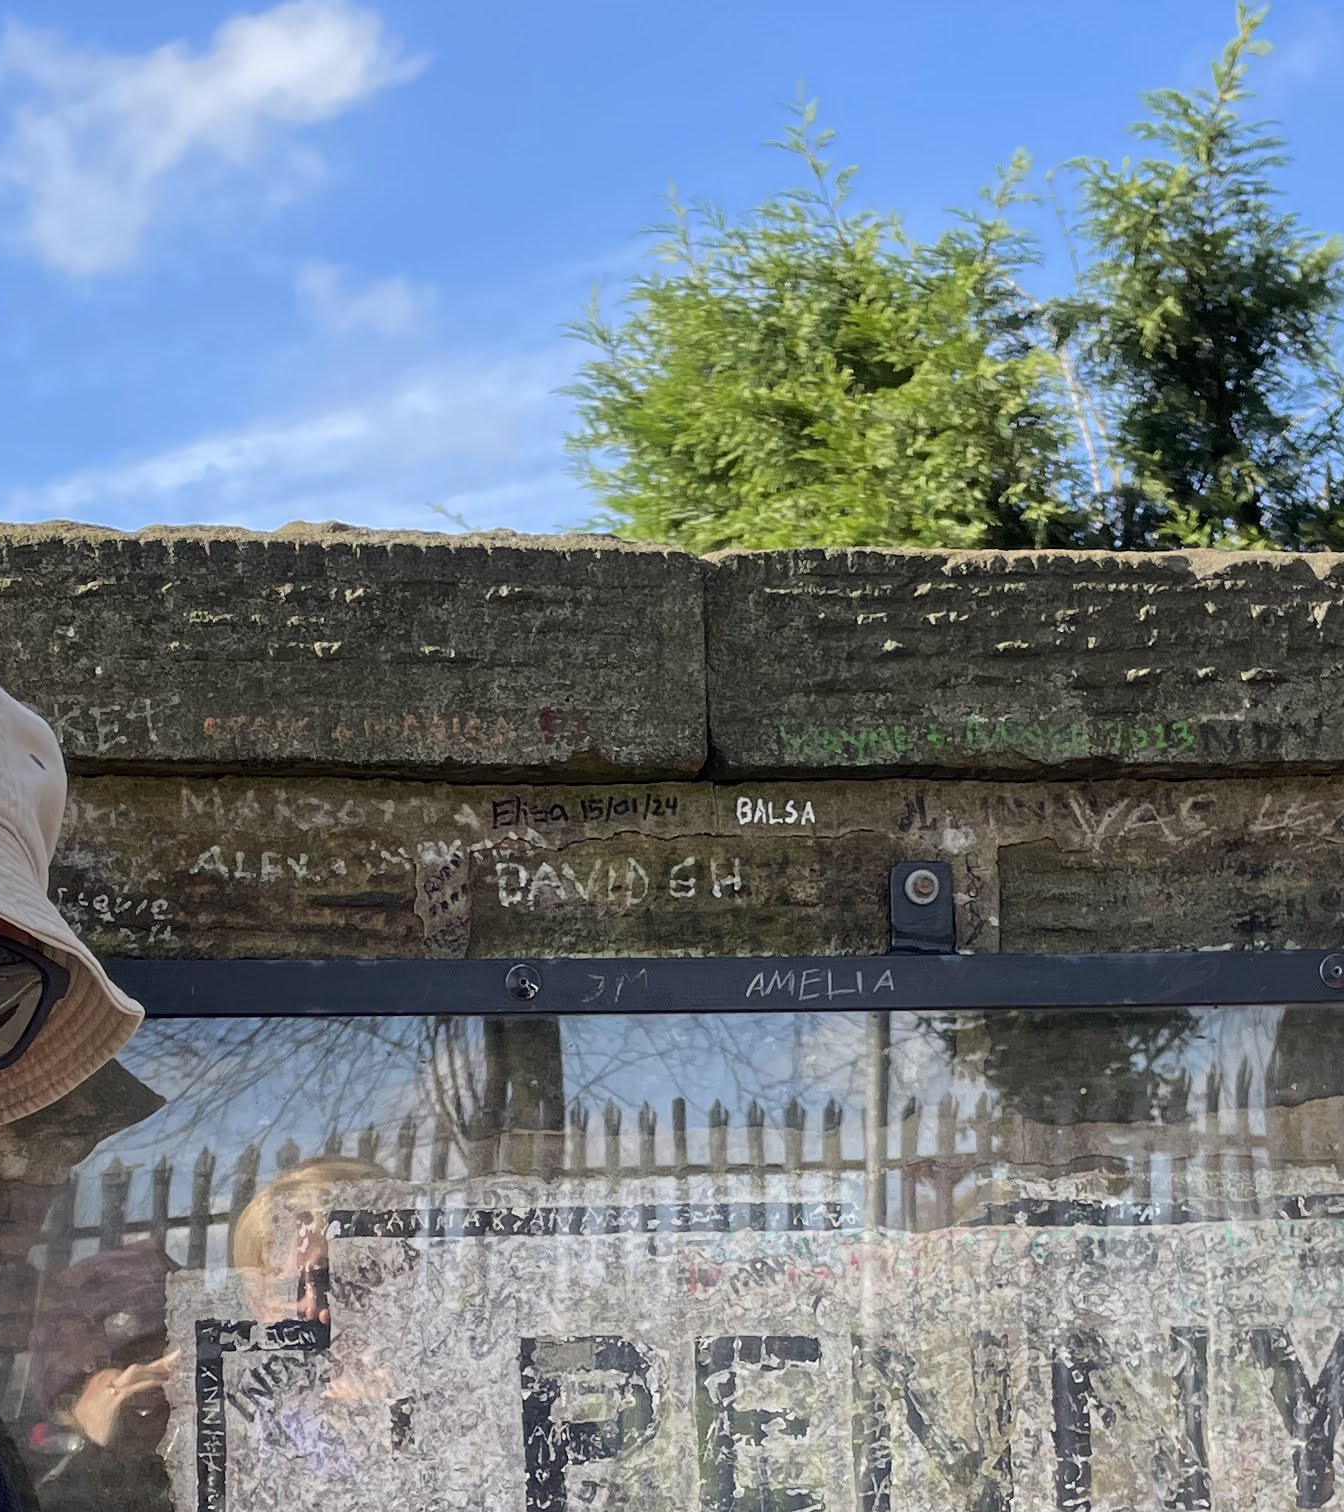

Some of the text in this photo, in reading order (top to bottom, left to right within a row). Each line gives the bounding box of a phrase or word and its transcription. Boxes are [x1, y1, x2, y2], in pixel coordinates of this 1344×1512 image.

[735, 795, 817, 826] BALSA
[494, 856, 651, 911] DAVID
[745, 967, 897, 1000] AMELIA
